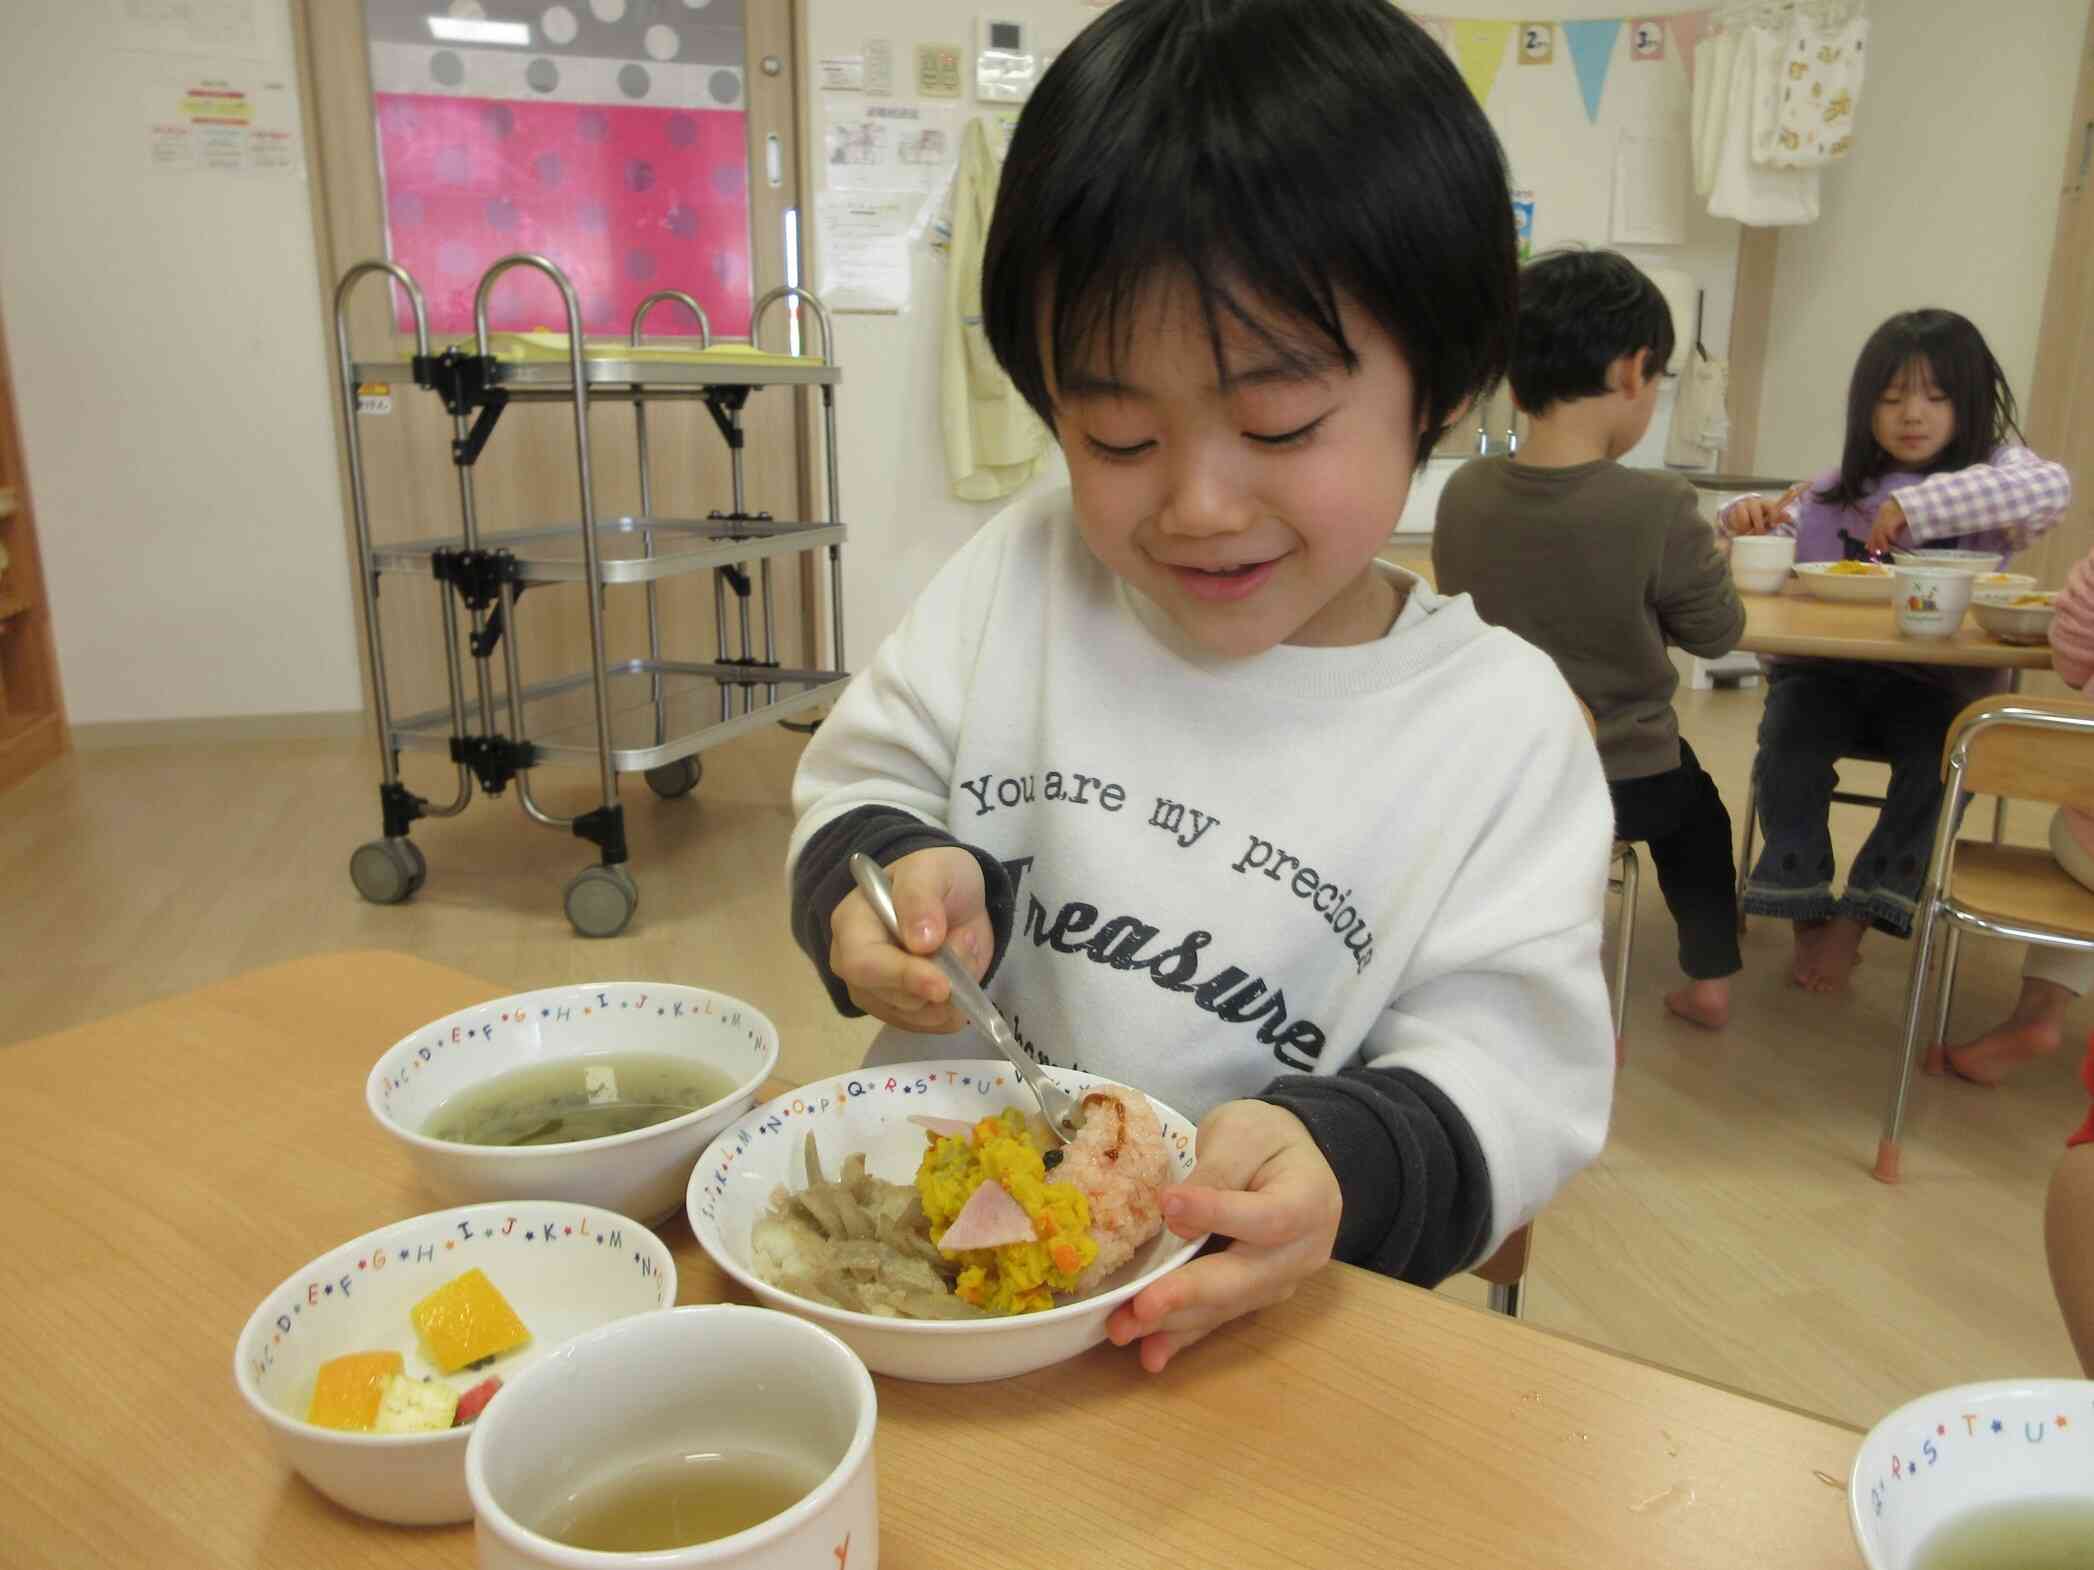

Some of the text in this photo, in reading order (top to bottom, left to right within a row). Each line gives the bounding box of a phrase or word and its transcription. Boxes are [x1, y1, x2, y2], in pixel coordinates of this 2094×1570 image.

[960, 774, 1035, 816] You
[1044, 771, 1126, 811] are
[1148, 798, 1221, 847] my
